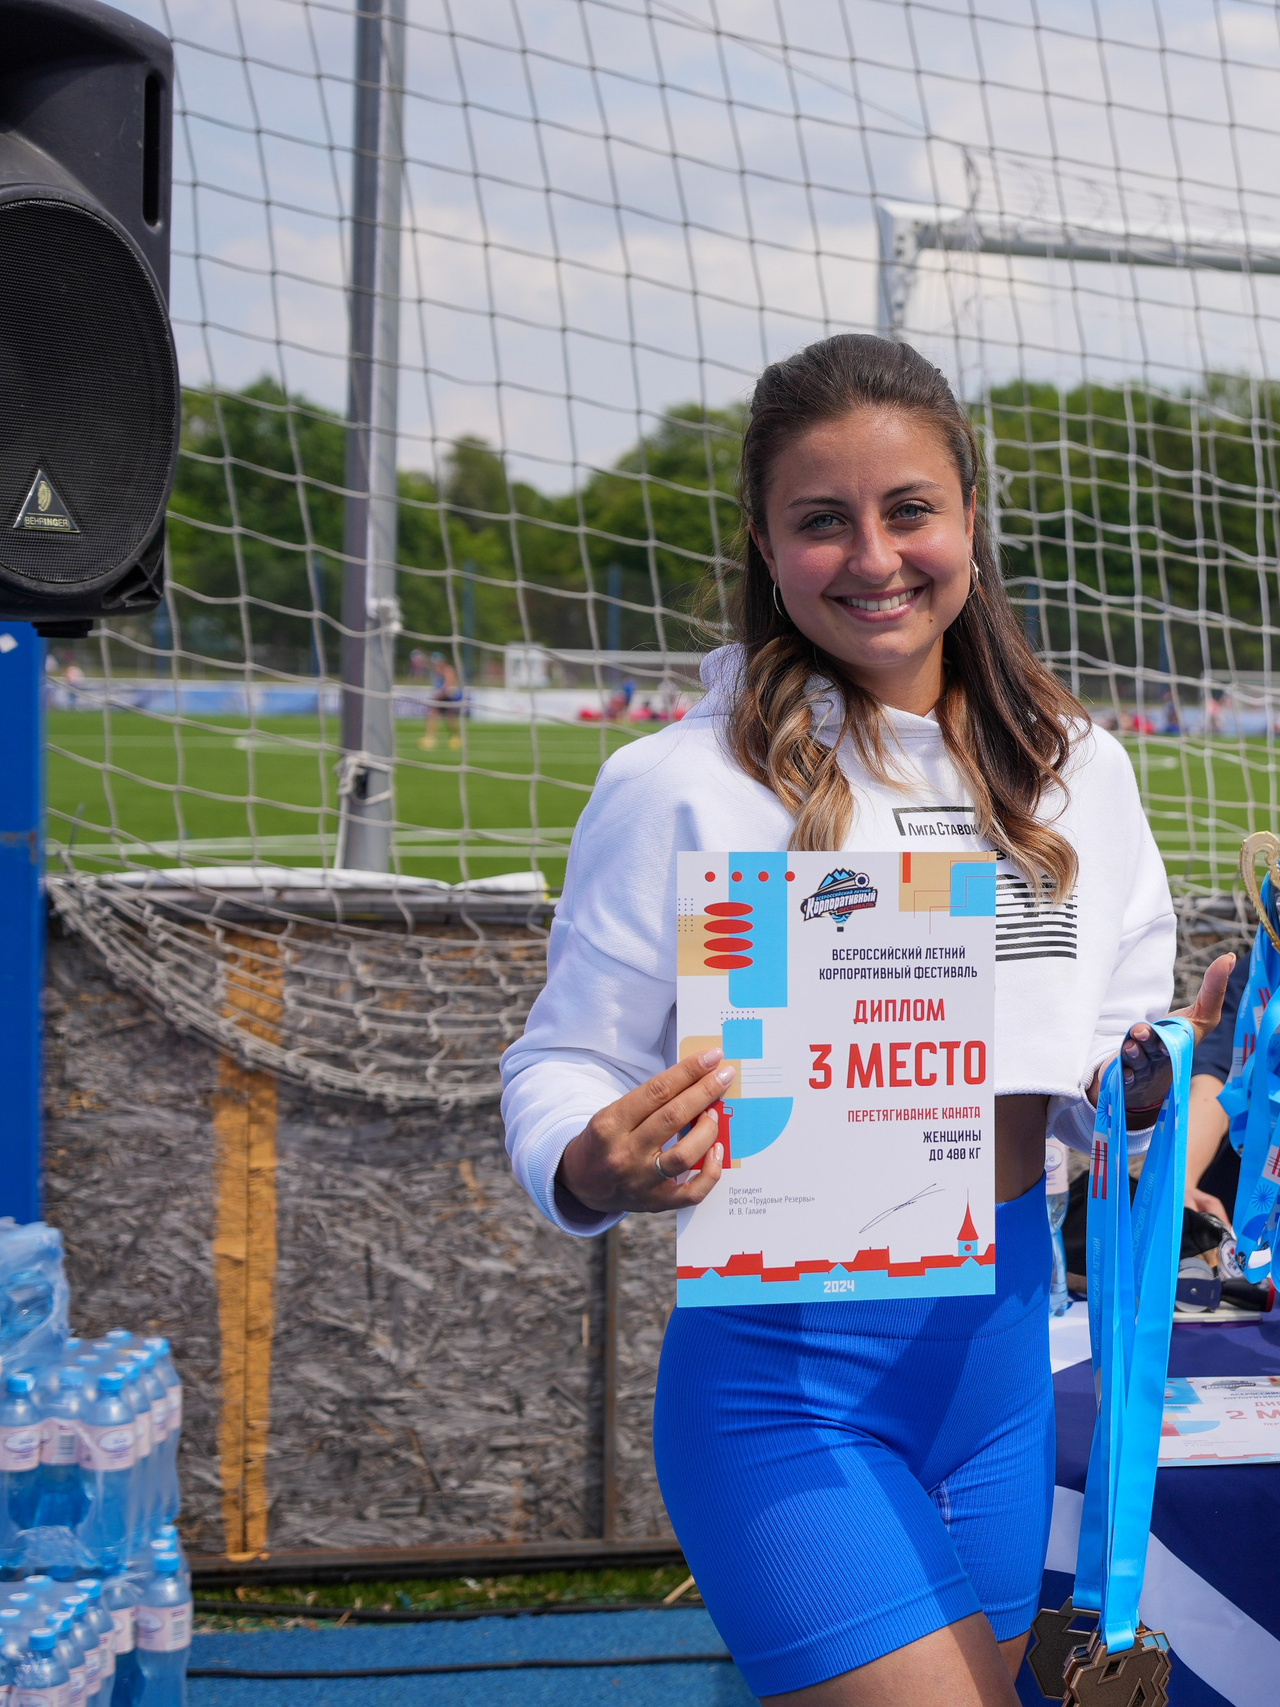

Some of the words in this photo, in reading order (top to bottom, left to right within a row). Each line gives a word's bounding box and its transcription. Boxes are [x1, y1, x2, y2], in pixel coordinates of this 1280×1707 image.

[24, 516, 69, 527] BEHRINGER
[832, 945, 922, 961] ВСЕРОССИЙСКИЙ
[925, 945, 966, 960] ЛЕТНИЙ
[819, 965, 911, 980] КОРПОРАТИВНЫЙ
[914, 966, 978, 979] ФЕСТИВАЛЬ
[853, 998, 946, 1025] ДИПЛОМ
[808, 1043, 832, 1090] 3
[846, 1040, 987, 1089] МЕСТО
[847, 1107, 939, 1123] ПЕРЕТЯГИВАНИЕ
[942, 1106, 981, 1120] КАНАТА
[923, 1129, 982, 1144] ЖЕНЩИНЫ
[929, 1149, 944, 1162] ДО
[946, 1147, 966, 1160] 480
[969, 1147, 982, 1160] КГ
[728, 1187, 763, 1196] Президент
[728, 1197, 748, 1206] ВФСО
[745, 1207, 767, 1215] Галаев
[823, 1279, 855, 1294] 2024
[1225, 1410, 1248, 1420] 2
